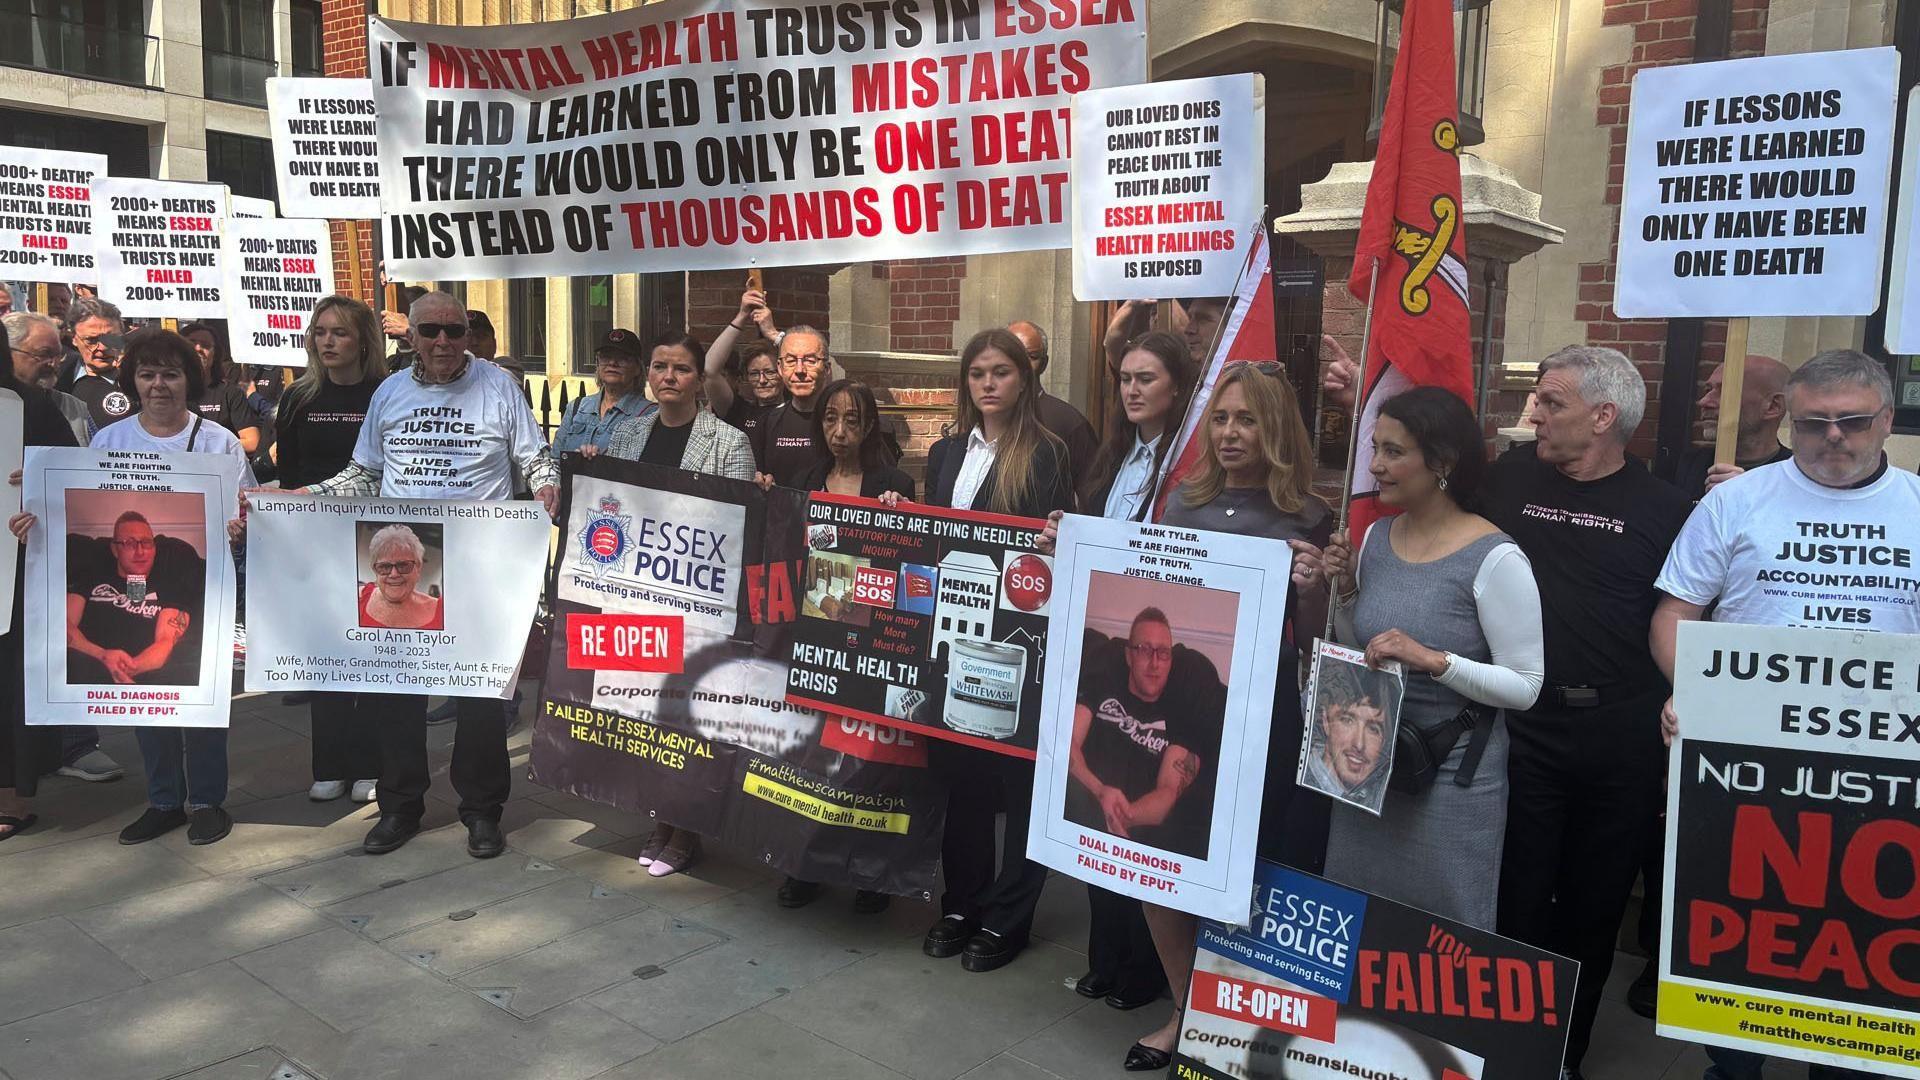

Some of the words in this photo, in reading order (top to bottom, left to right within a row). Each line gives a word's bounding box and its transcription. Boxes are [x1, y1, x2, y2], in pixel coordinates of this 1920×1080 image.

[380, 41, 416, 86] IF
[426, 42, 584, 91] MENTAL
[581, 11, 739, 80] HEALTH
[746, 3, 922, 57] TRUSTS
[935, 0, 980, 44] IN
[426, 100, 513, 145] HAD
[527, 77, 699, 143] LEARNED
[714, 67, 836, 123] FROM
[851, 41, 1090, 112] MISTAKES
[1106, 109, 1133, 127] OUR
[1137, 105, 1180, 125] LOVED
[1183, 100, 1221, 120] ONES
[1684, 100, 1709, 127] IF
[1714, 89, 1841, 126] LESSONS
[1107, 131, 1162, 151] CANNOT
[1165, 127, 1201, 145] REST
[1204, 125, 1219, 142] IN
[1656, 136, 1733, 167] WERE
[1740, 128, 1865, 162] LEARNED
[403, 155, 525, 201] THERE
[534, 141, 684, 196] WOULD
[695, 130, 798, 186] ONLY
[810, 127, 865, 178] BE
[874, 118, 960, 174] ONE
[1108, 156, 1149, 175] PEACE
[1152, 152, 1192, 171] UNTIL
[1195, 150, 1222, 167] THE
[1115, 179, 1159, 198] TRUTH
[1162, 175, 1211, 195] ABOUT
[1659, 174, 1743, 204] THERE
[1750, 168, 1856, 199] WOULD
[111, 197, 158, 212] 2000+
[162, 198, 216, 213] DEATHS
[391, 208, 554, 259] INSTEAD
[563, 205, 612, 252] OF
[621, 188, 882, 249] THOUSANDS
[893, 182, 944, 234] OF
[957, 173, 1068, 230] DEAT
[1104, 206, 1154, 227] ESSEX
[1157, 201, 1225, 224] MENTAL
[118, 215, 166, 230] MEANS
[169, 216, 213, 231] ESSEX
[1642, 213, 1709, 241] ONLY
[1714, 210, 1787, 239] HAVE
[1793, 206, 1867, 236] BEEN
[112, 233, 167, 247] MENTAL
[169, 234, 220, 249] HEALTH
[1096, 234, 1153, 256] HEALTH
[1157, 230, 1235, 253] FAILINGS
[120, 251, 176, 265] TRUSTS
[179, 252, 216, 266] HAVE
[1124, 261, 1138, 278] IS
[1141, 259, 1202, 277] EXPOSED
[1674, 250, 1726, 277] ONE
[1733, 247, 1825, 276] DEATH
[147, 269, 193, 283] FAILED
[126, 287, 173, 300] 2000+
[176, 287, 220, 301] TIMES
[413, 407, 462, 418] TRUTH
[401, 420, 475, 434] JUSTICE
[388, 438, 482, 448] ACCOUNTABILITY
[403, 467, 458, 477] MATTER
[412, 458, 452, 467] LIVES
[257, 500, 317, 515] Lampard
[320, 502, 366, 516] Inquiry
[370, 503, 395, 515] into
[400, 504, 444, 517] Mental
[448, 506, 490, 518] Health
[494, 507, 539, 520] Deaths
[810, 504, 831, 520] OUR
[834, 508, 871, 525] LOVED
[874, 513, 904, 530] ONES
[907, 517, 929, 533] ARE
[933, 520, 969, 538] DYING
[1523, 508, 1566, 522] HUMAN
[1571, 517, 1624, 533] RIGHTS
[639, 518, 727, 564] ESSEX
[1797, 522, 1885, 539] TRUTH
[1776, 542, 1910, 568] JUSTICE
[634, 552, 726, 594] POLICE
[857, 572, 893, 585] HELP
[1011, 574, 1045, 592] SOS
[1757, 569, 1920, 592] ACCOUNTABILITY
[574, 576, 628, 598] Protecting
[630, 590, 651, 601] and
[652, 593, 691, 612] serving
[693, 602, 723, 618] Essex
[942, 578, 993, 596] MENTAL
[1764, 588, 1789, 597] WWW.
[1792, 591, 1815, 599] CURE
[941, 592, 990, 610] HEALTH
[1804, 605, 1871, 623] LIVES
[346, 629, 380, 642] Carol
[384, 630, 411, 643] Ann
[415, 631, 457, 647] Taylor
[374, 645, 397, 655] 1948
[406, 647, 431, 657] 2023
[581, 625, 606, 656] RE
[614, 625, 668, 658] OPEN
[276, 656, 304, 667] Wife,
[307, 656, 347, 668] Mother,
[349, 657, 420, 670] Grandmother,
[422, 660, 452, 672] Sister,
[454, 662, 478, 672] Aunt
[792, 642, 851, 672] MENTAL
[961, 661, 1012, 679] Government
[1703, 650, 1894, 690] JUSTICE
[265, 670, 289, 681] Too
[293, 670, 328, 684] Many
[331, 671, 361, 682] Lives
[365, 672, 392, 685] Lost,
[396, 673, 445, 688] Changes
[449, 675, 484, 687] MUST
[789, 667, 838, 695] CRISIS
[956, 680, 1013, 701] WHITEWASH
[546, 702, 593, 724] FAILED
[597, 713, 614, 730] BY
[617, 719, 656, 742] ESSEX
[659, 732, 714, 758] MENTAL
[1781, 704, 1920, 744] ESSEX
[571, 725, 624, 749] HEALTH
[627, 739, 685, 770] SERVICES
[749, 757, 906, 812] #matthewscampaign
[1699, 753, 1764, 793] NO
[793, 797, 820, 816] mental
[822, 806, 854, 824] health
[856, 815, 887, 829] .co.uk
[1079, 835, 1109, 853] DUAL
[1112, 844, 1182, 874] DIAGNOSIS
[1729, 805, 1920, 919] NO
[1077, 854, 1116, 876] FAILED
[1119, 868, 1137, 882] BY
[1139, 874, 1179, 894] EPUT.
[1267, 888, 1354, 941] ESSEX
[1261, 917, 1349, 968] POLICE
[1688, 899, 1920, 998] PEAC
[1204, 930, 1252, 957] Protecting
[1254, 952, 1273, 964] and
[1274, 958, 1312, 980] serving
[1313, 972, 1342, 990] Essex
[1358, 950, 1557, 1026] FAILED!
[1217, 980, 1308, 1028] RE-OPEN
[1695, 991, 1740, 1008] www.
[1745, 1000, 1784, 1015] cure
[1789, 1006, 1851, 1025] mental
[1857, 1016, 1916, 1036] health
